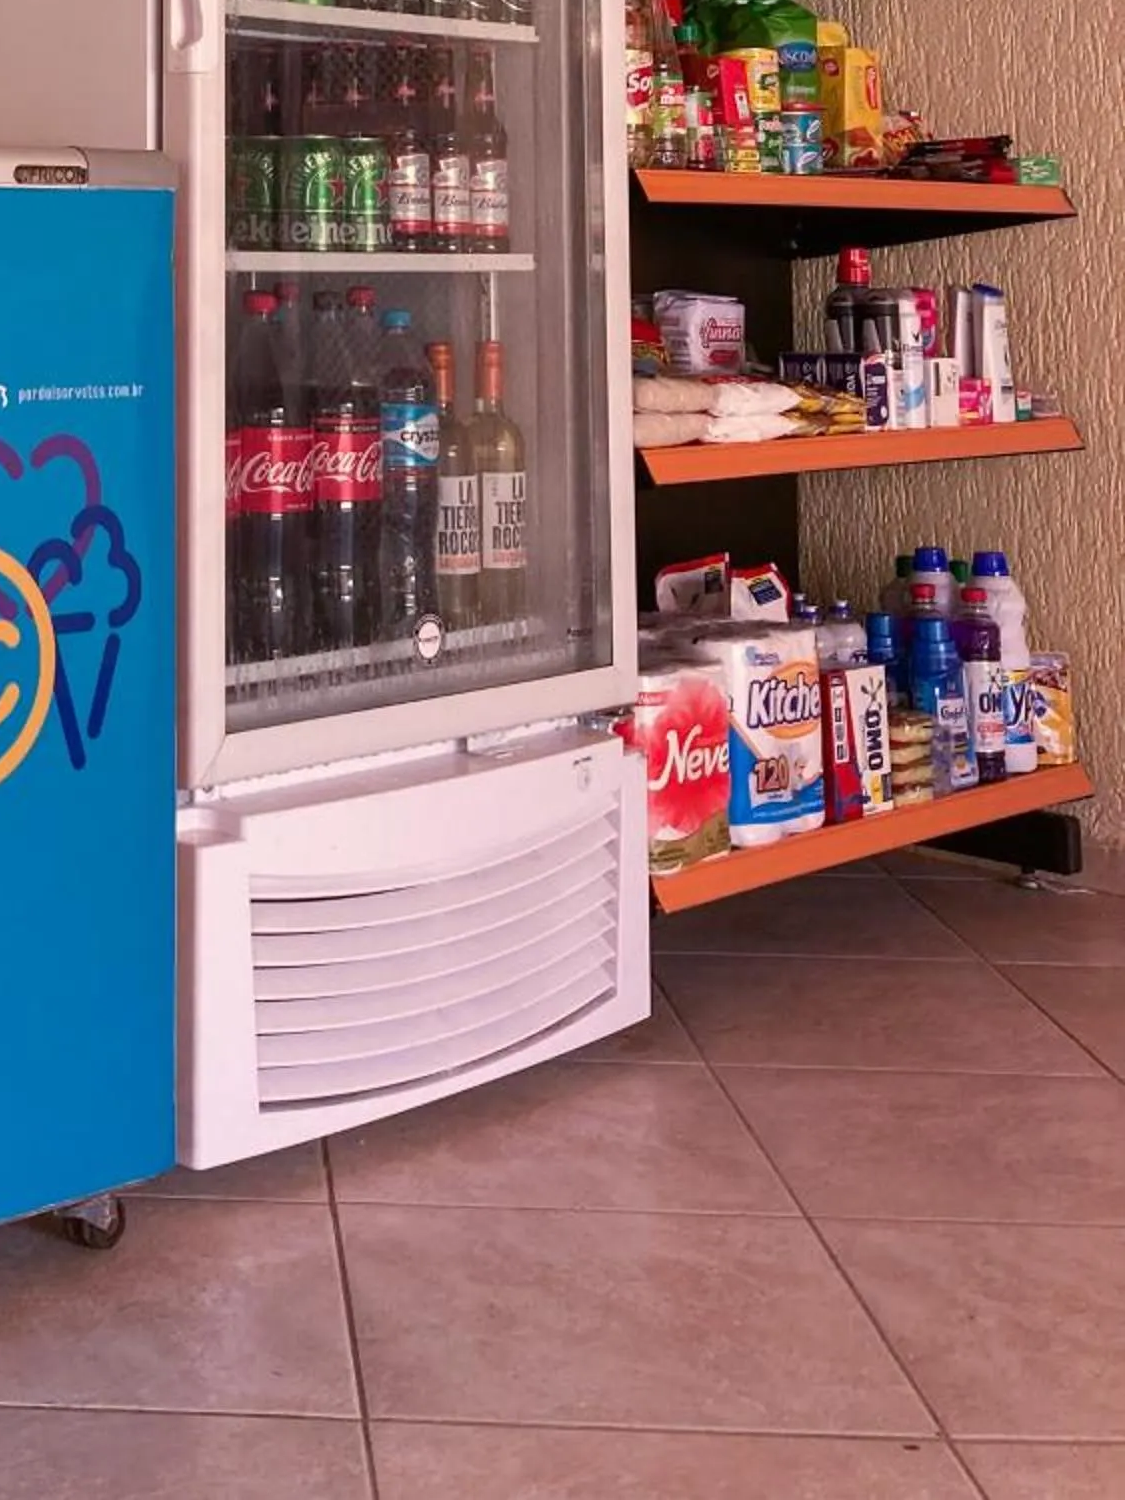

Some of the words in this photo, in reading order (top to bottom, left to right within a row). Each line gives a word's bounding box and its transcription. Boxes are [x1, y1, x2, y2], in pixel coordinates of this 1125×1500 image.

[400, 429, 439, 445] cryst
[458, 480, 474, 505] LA
[747, 672, 822, 729] Kitche
[647, 724, 730, 792] Neve
[865, 708, 885, 772] OMO
